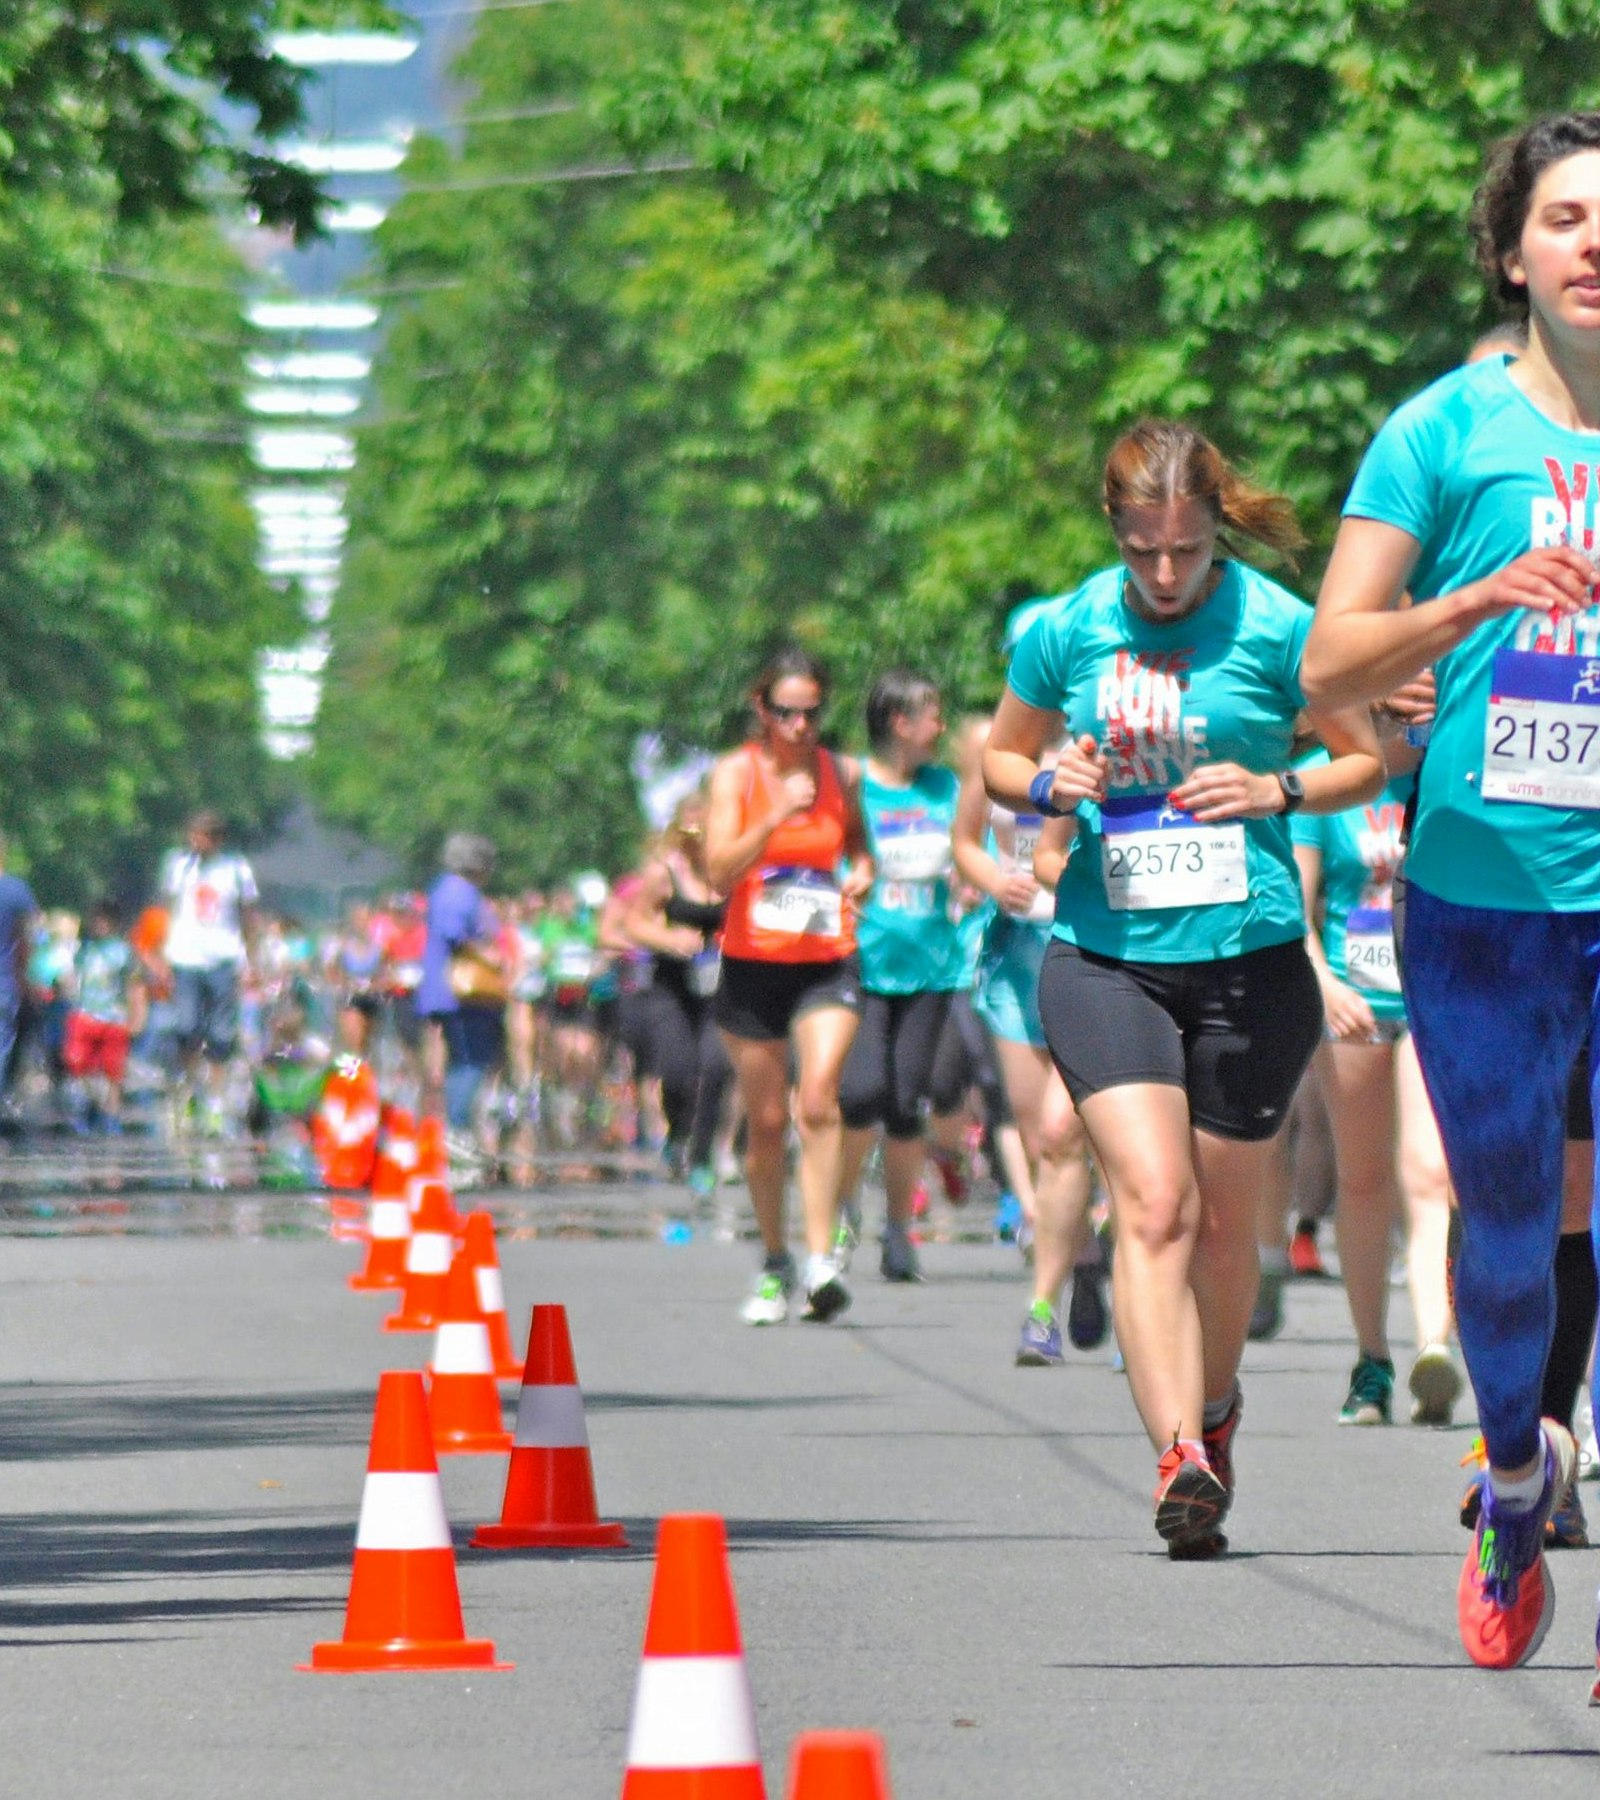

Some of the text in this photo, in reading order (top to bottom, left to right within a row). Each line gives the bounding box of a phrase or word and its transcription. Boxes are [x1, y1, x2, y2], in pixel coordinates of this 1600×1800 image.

[1115, 647, 1197, 692] VIE
[1096, 674, 1181, 735] RUN
[1109, 841, 1204, 879] 22573
[1350, 944, 1398, 969] 246
